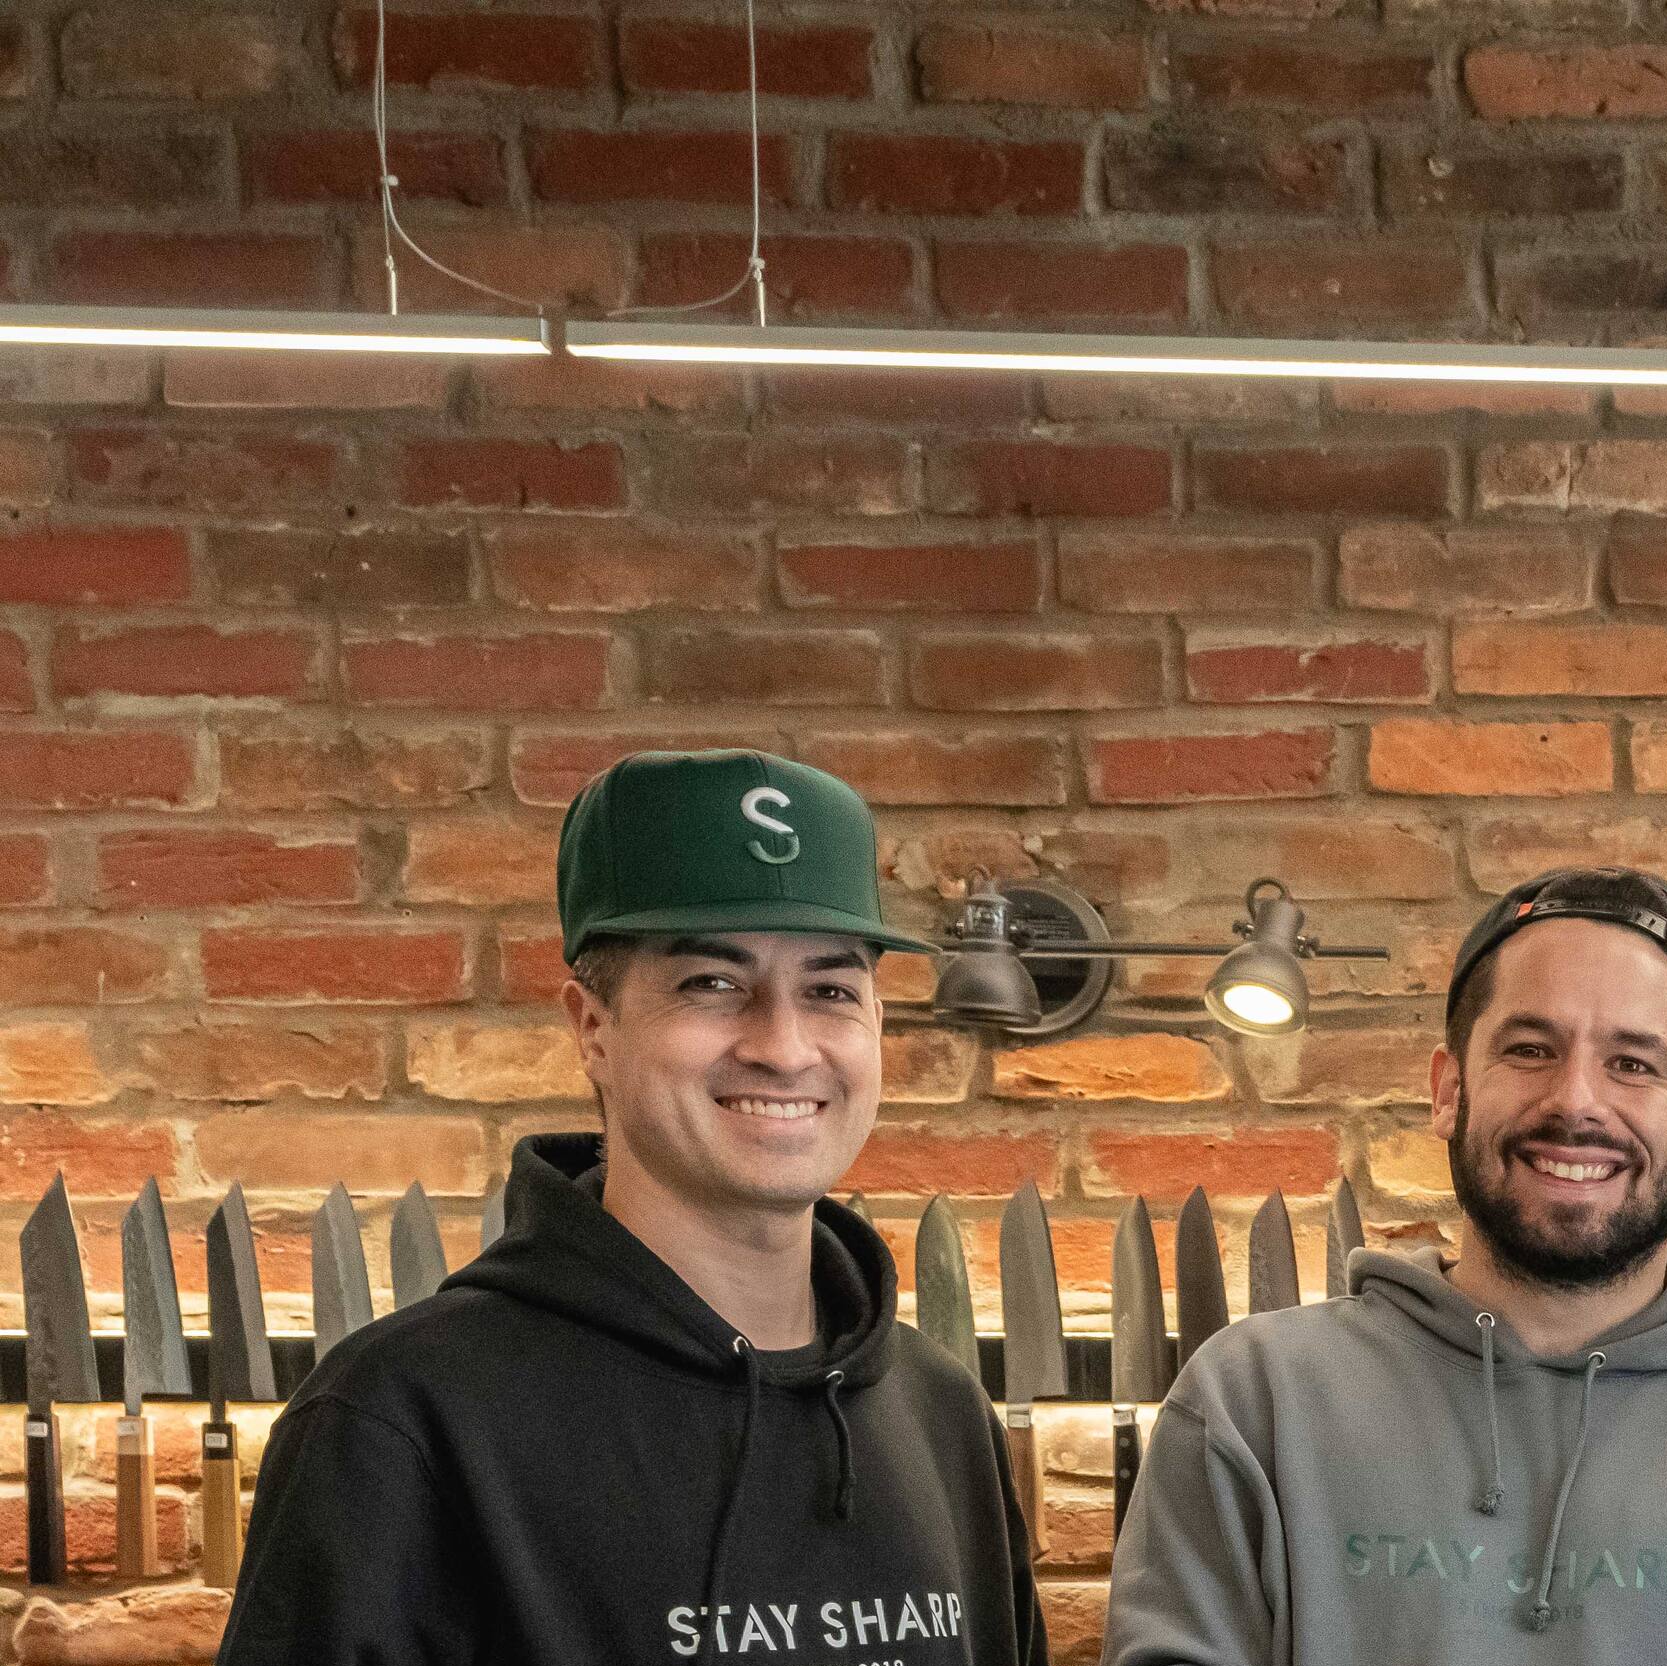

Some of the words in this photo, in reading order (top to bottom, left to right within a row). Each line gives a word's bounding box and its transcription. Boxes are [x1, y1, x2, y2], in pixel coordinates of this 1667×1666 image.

[741, 787, 800, 864] S
[1346, 1534, 1484, 1580] STAY
[667, 1603, 797, 1656] STAY
[820, 1592, 961, 1648] SHARP
